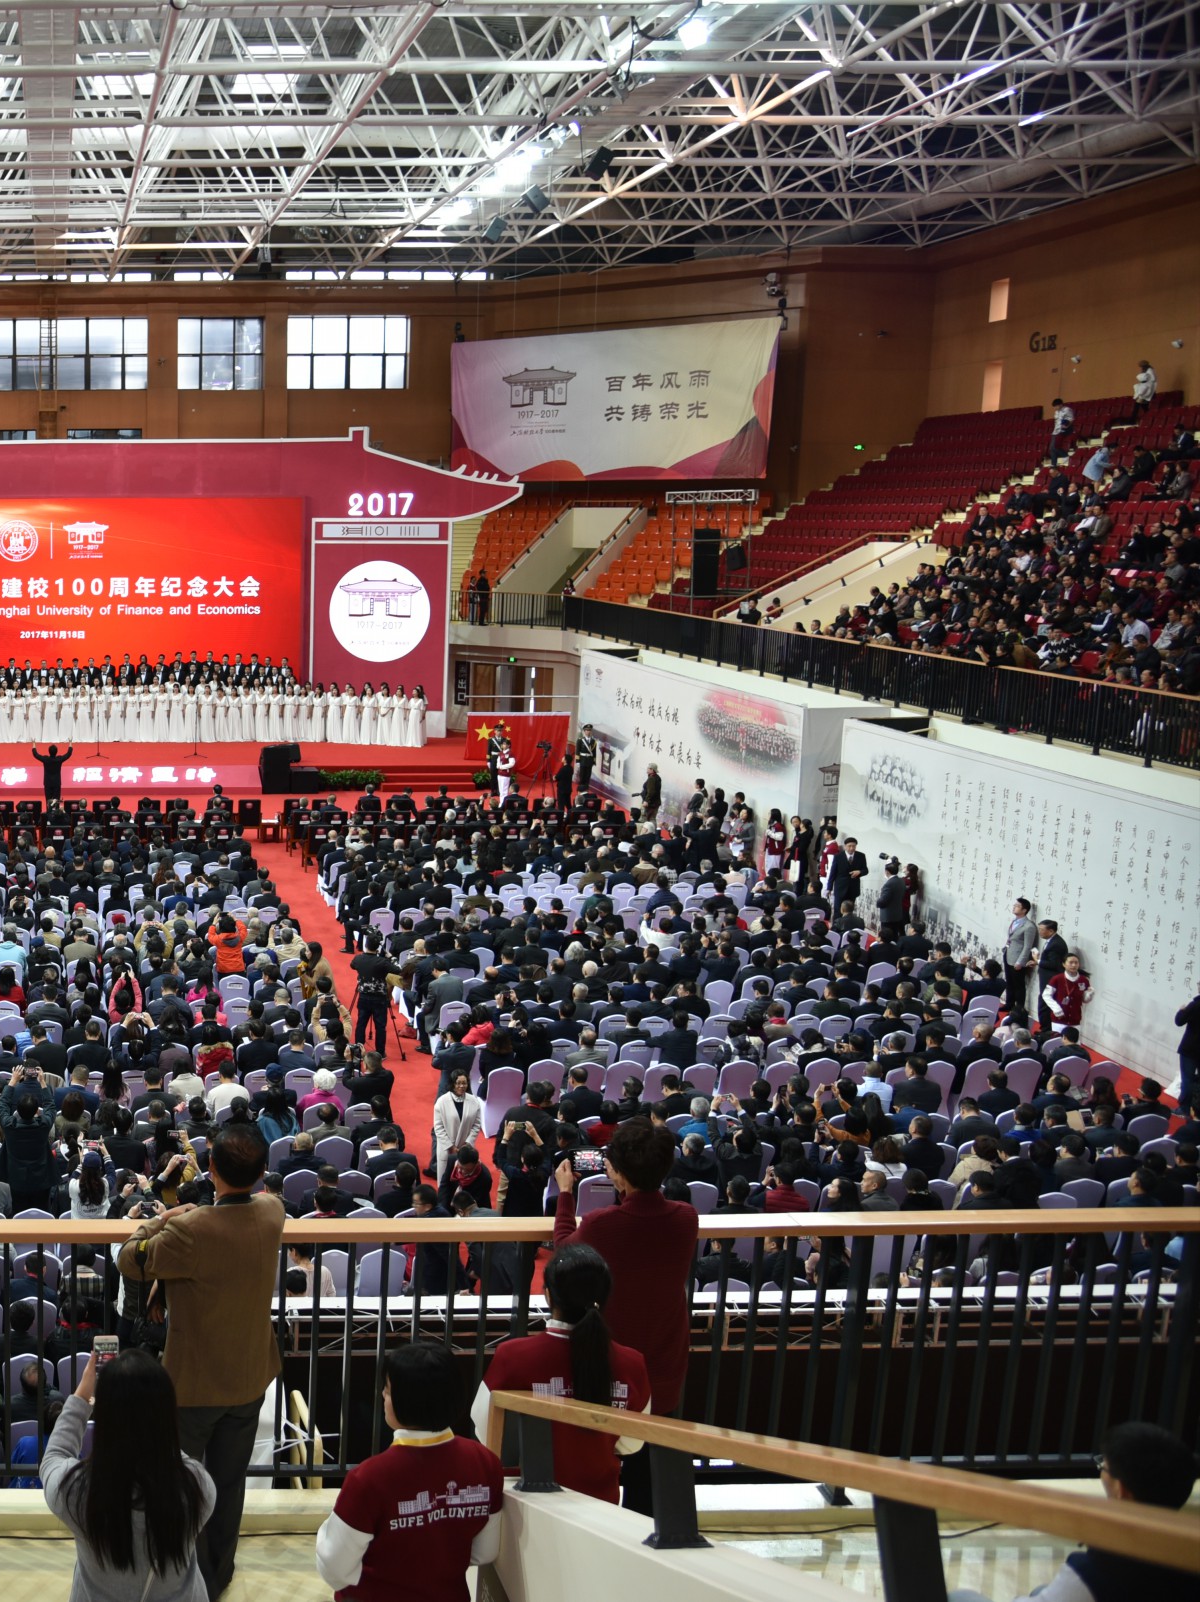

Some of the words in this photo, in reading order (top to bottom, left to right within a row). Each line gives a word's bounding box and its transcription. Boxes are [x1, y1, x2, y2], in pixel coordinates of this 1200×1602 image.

[605, 370, 712, 392] 百年风雨
[604, 401, 710, 422] 共铸荣光
[347, 492, 415, 517] 2017
[36, 604, 94, 618] University
[99, 604, 112, 616] of
[117, 604, 164, 616] Finance
[169, 604, 191, 616] and
[197, 604, 261, 616] Economics
[19, 630, 85, 640] 2017年11月18日
[389, 1515, 424, 1531] SUFE
[427, 1505, 491, 1524] VOLUNTEE
